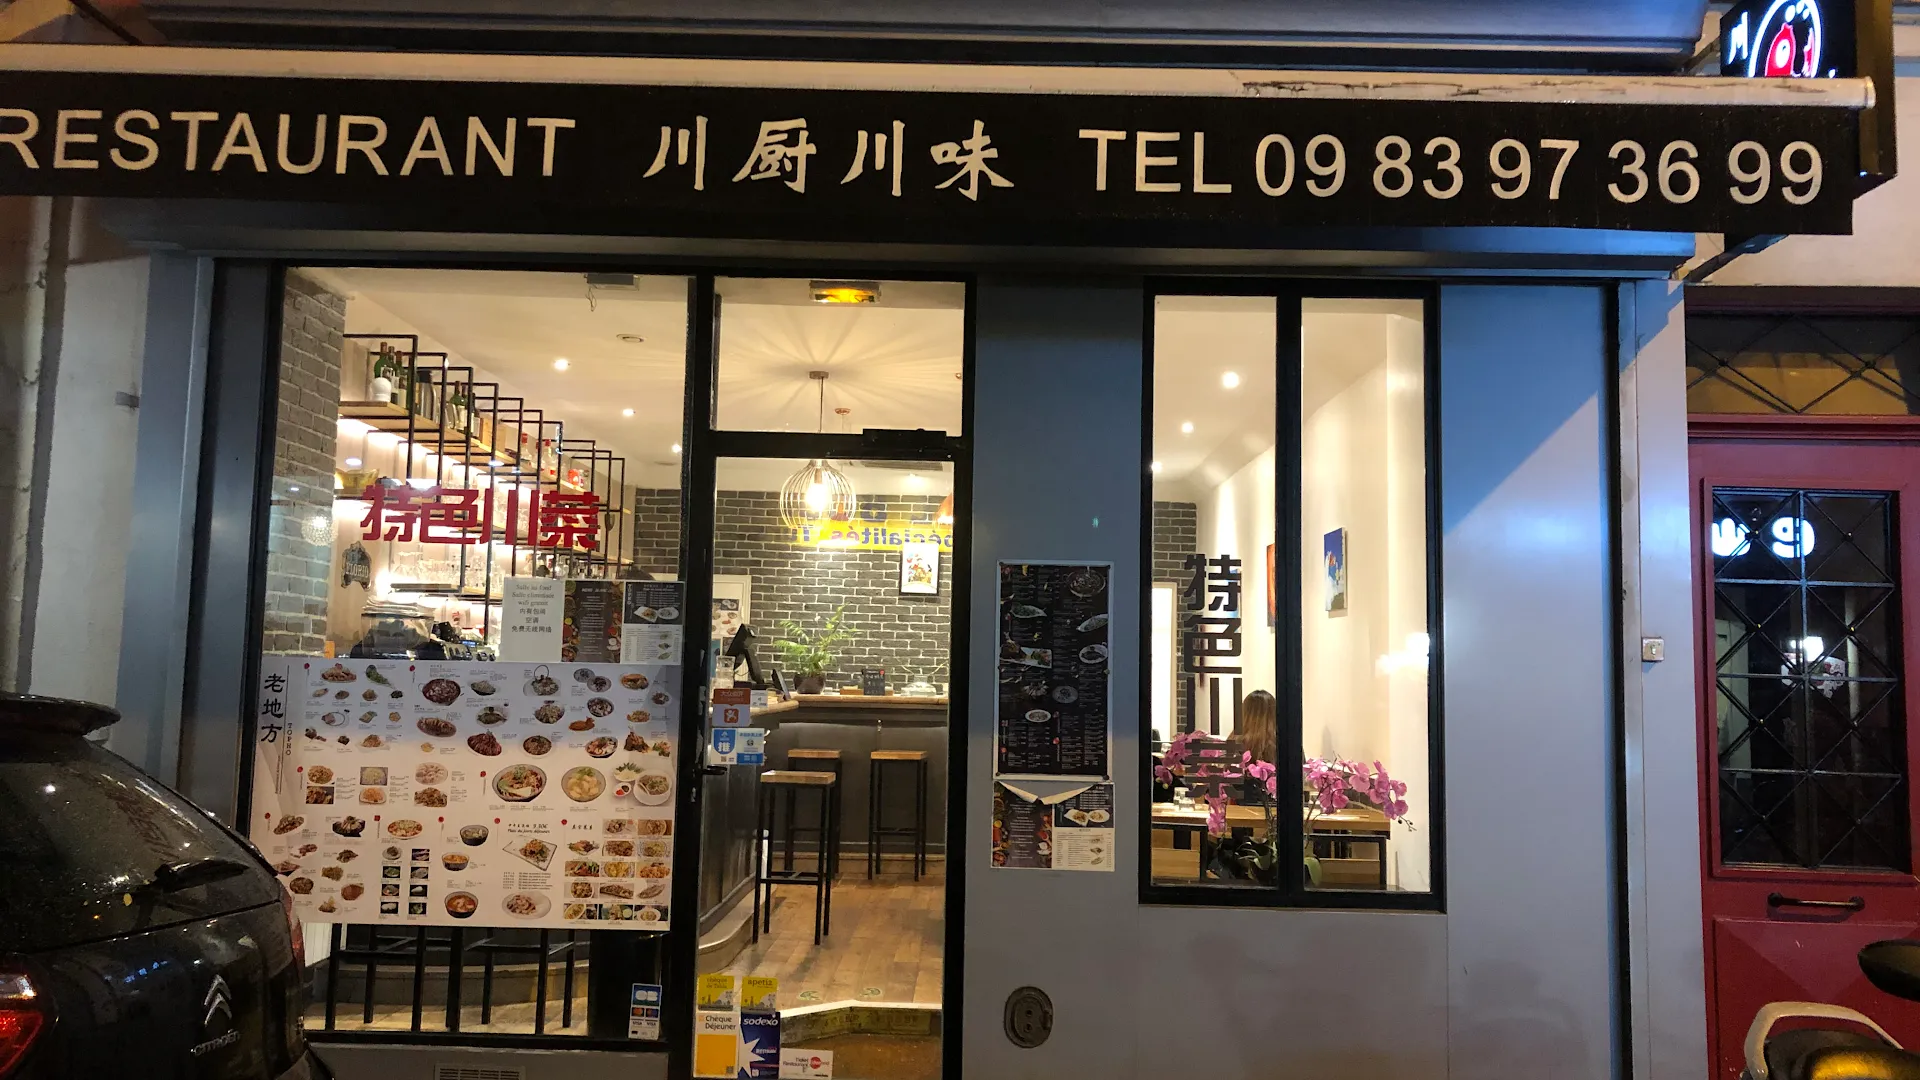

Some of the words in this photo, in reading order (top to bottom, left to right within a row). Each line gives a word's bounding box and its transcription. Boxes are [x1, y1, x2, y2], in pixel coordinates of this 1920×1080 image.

[0, 108, 576, 177] RESTAURANT
[643, 115, 1014, 201] 川厨川味
[1079, 128, 1232, 193] TEL
[1254, 132, 1347, 198] 09
[1372, 135, 1464, 200] 83
[1489, 138, 1580, 201] 97
[1607, 139, 1700, 203] 36
[1728, 140, 1823, 205] 99
[360, 484, 601, 548] 特色川菜
[260, 673, 285, 743] 老地方
[1183, 554, 1245, 799] 特色川菜
[705, 1022, 737, 1031] Déjeuner
[743, 1016, 779, 1026] sodexo
